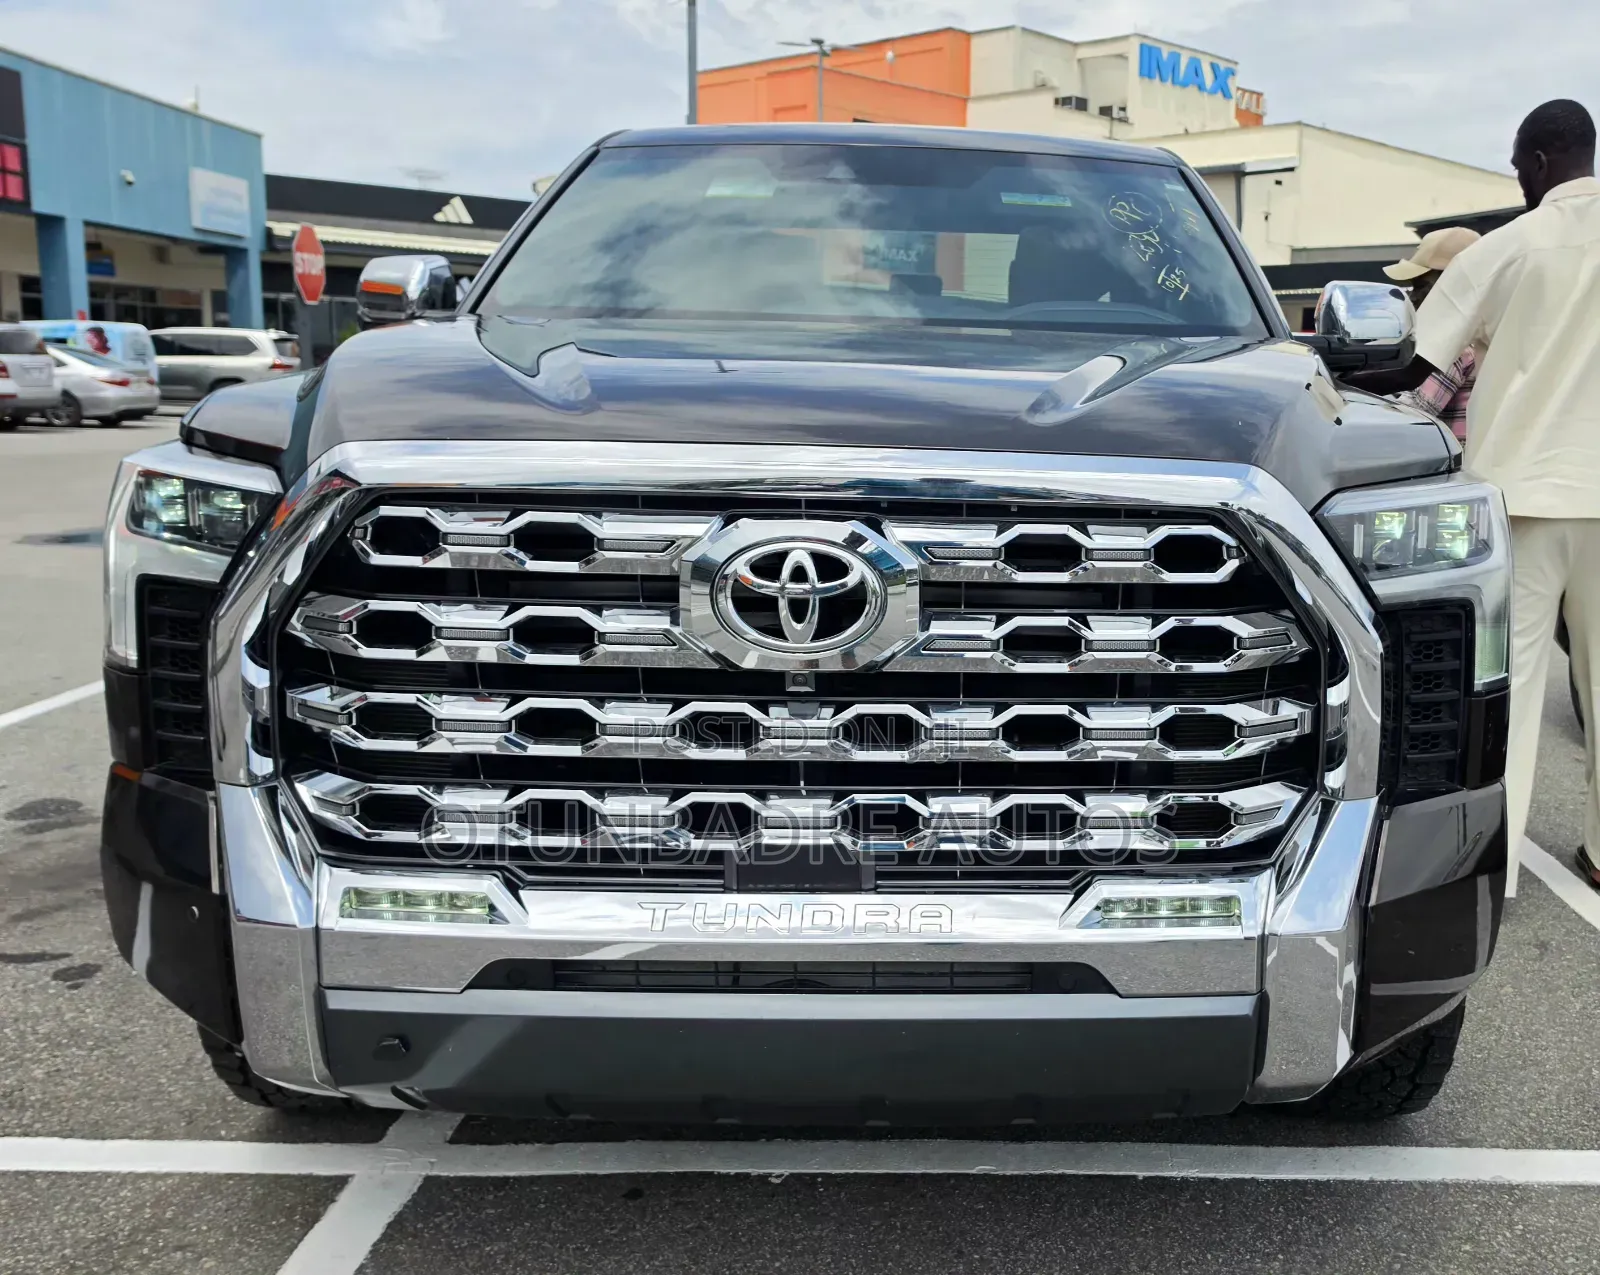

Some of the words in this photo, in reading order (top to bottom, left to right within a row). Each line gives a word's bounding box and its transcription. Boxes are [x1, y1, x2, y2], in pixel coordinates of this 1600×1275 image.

[1139, 43, 1236, 100] IMAX
[294, 251, 320, 271] STOP
[637, 902, 953, 934] TUNDRA
